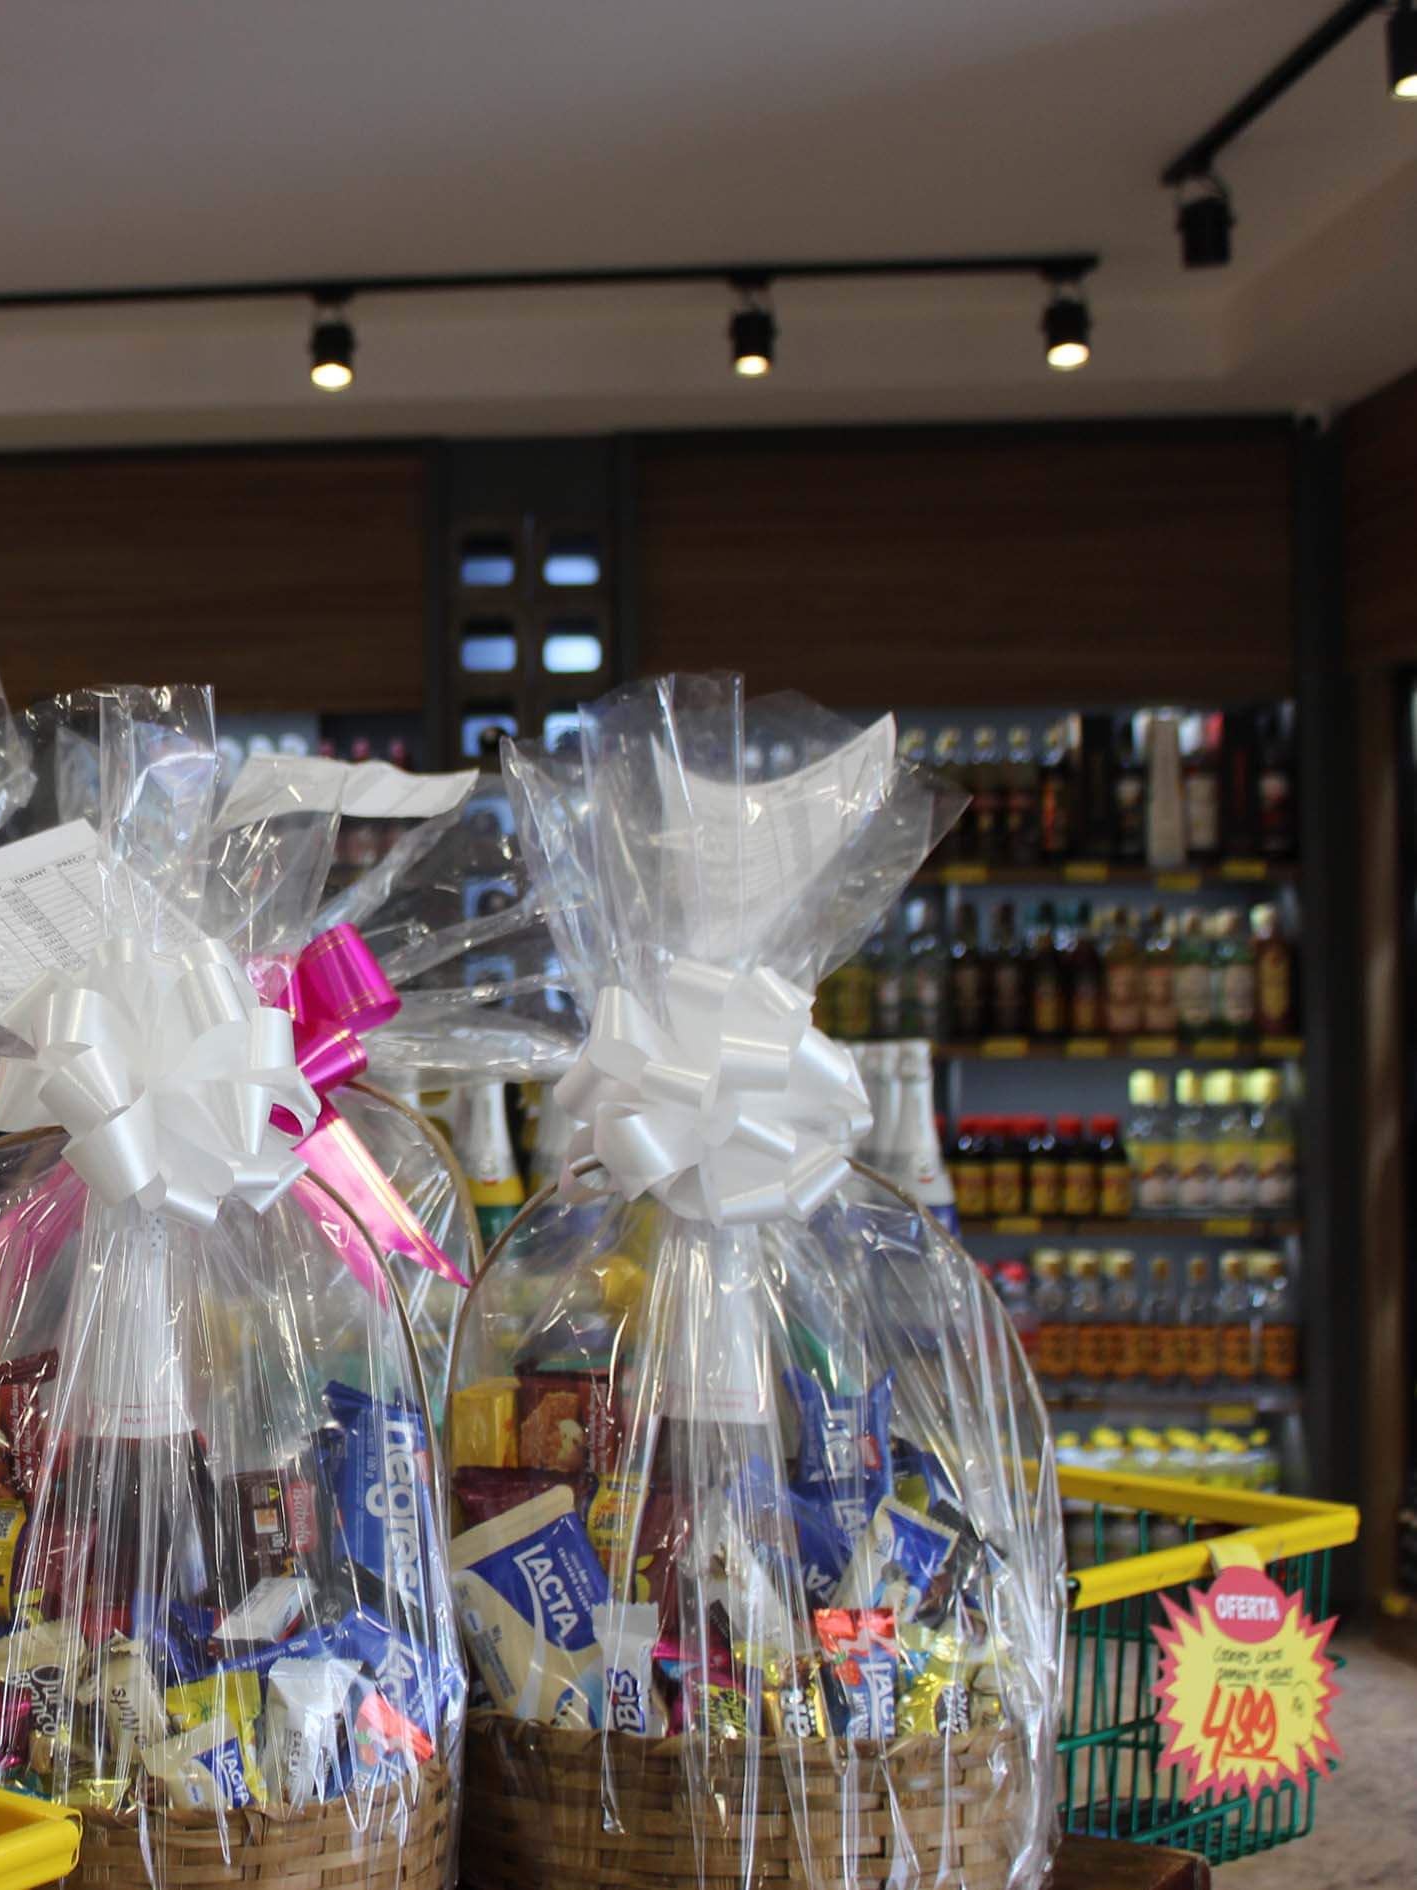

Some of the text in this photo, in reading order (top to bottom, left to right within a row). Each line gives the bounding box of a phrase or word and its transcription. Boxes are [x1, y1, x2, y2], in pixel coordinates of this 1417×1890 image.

[366, 1420, 417, 1604] negres
[512, 1543, 580, 1638] LACTA
[1214, 1594, 1280, 1622] OFERTA
[606, 1668, 646, 1734] BIS
[221, 1748, 251, 1807] LACTA
